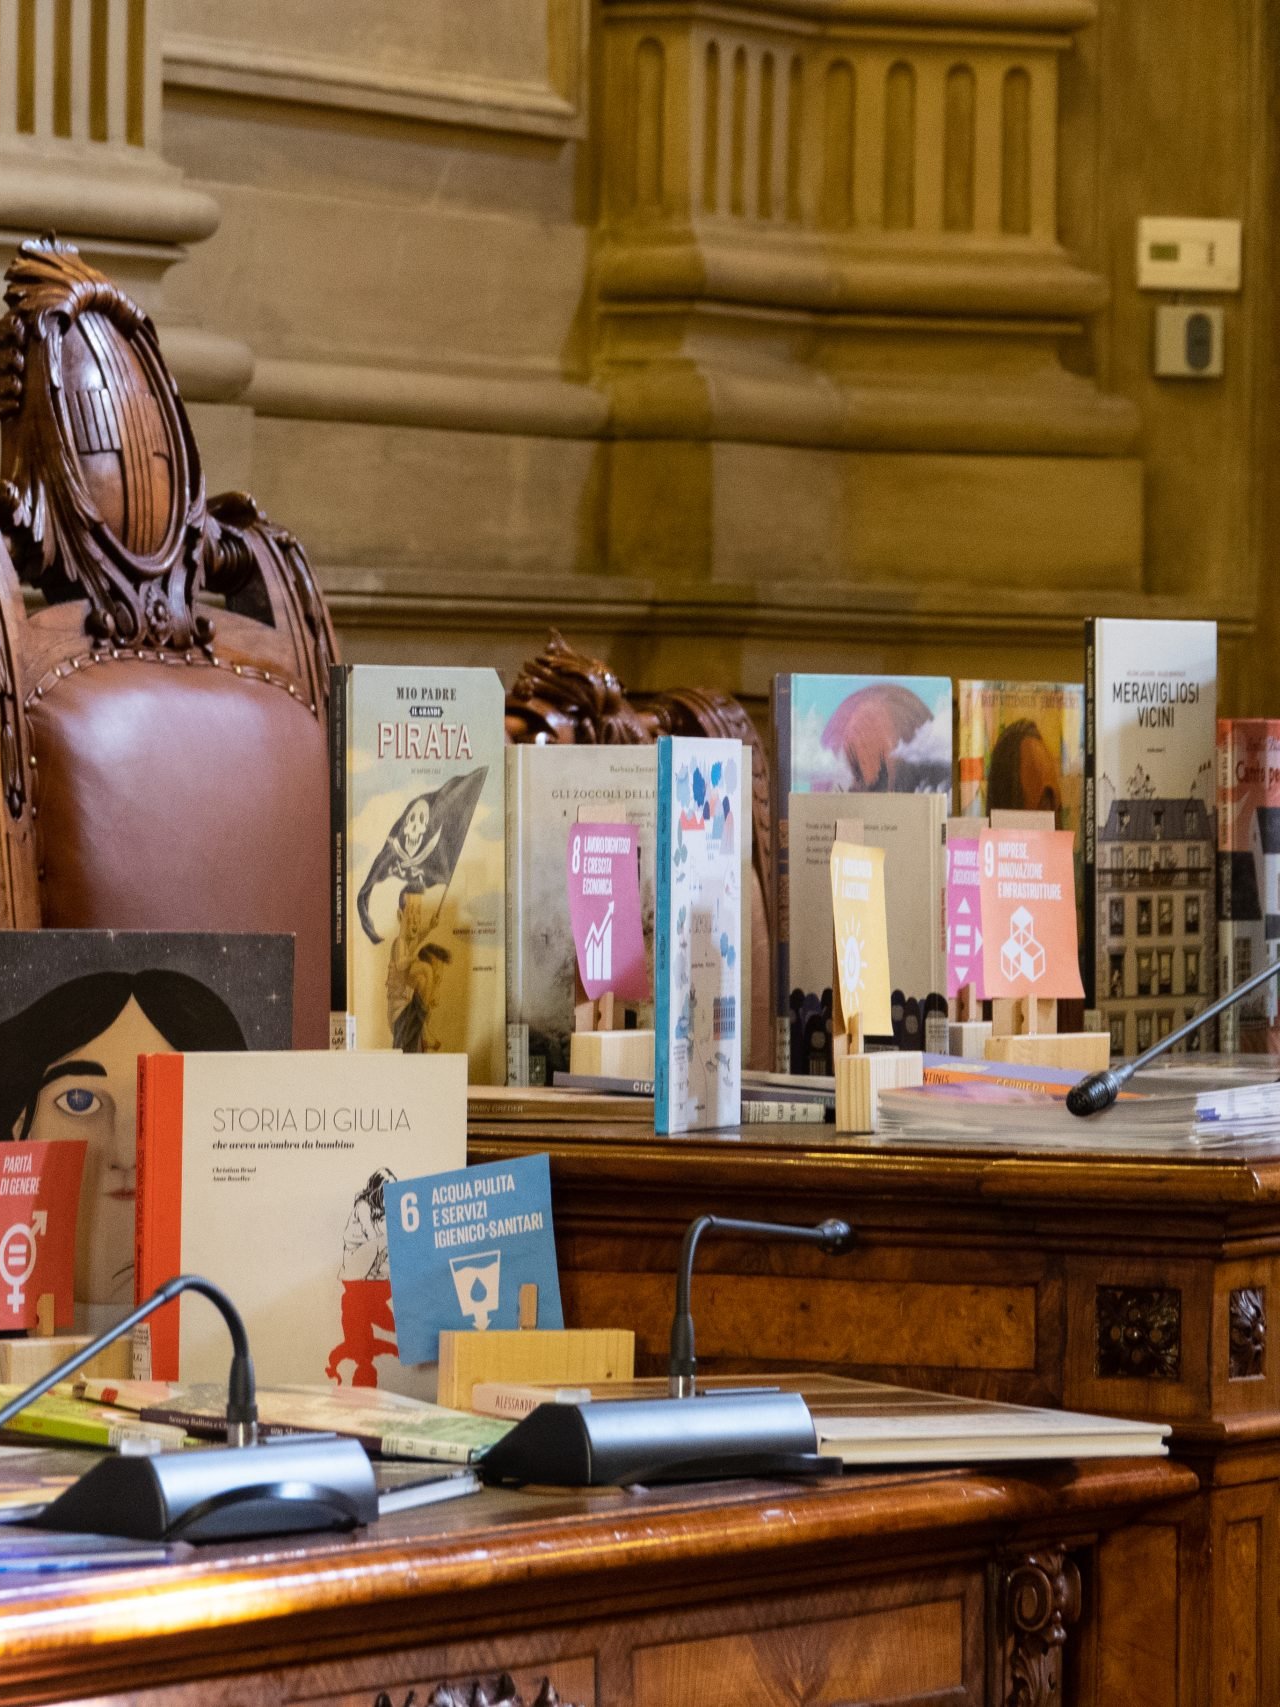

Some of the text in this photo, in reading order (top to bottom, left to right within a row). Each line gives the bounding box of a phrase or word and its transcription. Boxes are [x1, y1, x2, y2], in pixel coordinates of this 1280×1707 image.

[396, 687, 457, 702] MIO PADRE
[1112, 682, 1200, 704] MERAVIGLIOSI
[1137, 706, 1175, 728] VICINI
[377, 721, 473, 760] PIRATA
[551, 790, 570, 800] GLI
[573, 790, 622, 800] ZOCCOLI
[572, 835, 581, 875] 8
[984, 840, 995, 878] 9
[213, 1106, 412, 1133] STORIA DI GIULIA
[212, 1139, 355, 1150] che aveva un'ombra da bambino
[2, 1152, 33, 1174] PARITÀ
[0, 1176, 42, 1197] DI GENERE
[400, 1174, 516, 1233] 6 ACQUA PULITA
[432, 1200, 488, 1228] E SERVIZI
[434, 1211, 544, 1249] IGIENICO-SANITARI
[190, 1417, 213, 1429] Ballista
